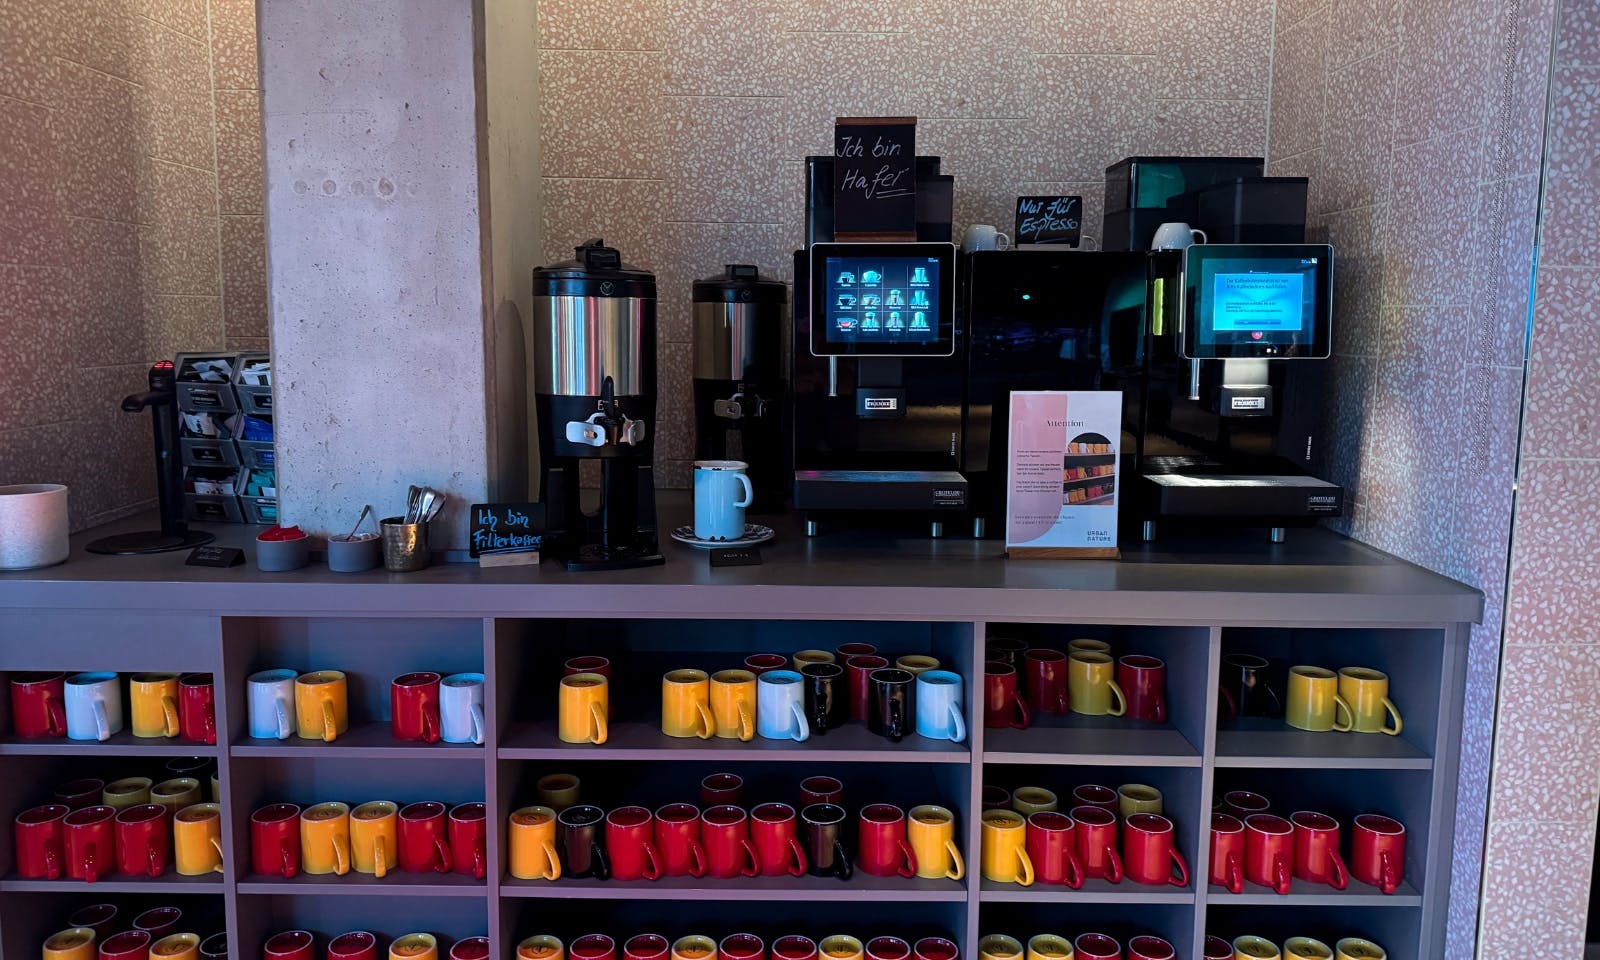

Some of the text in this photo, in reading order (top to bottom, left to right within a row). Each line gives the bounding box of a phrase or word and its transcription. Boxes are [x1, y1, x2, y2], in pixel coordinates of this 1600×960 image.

[836, 136, 902, 158] Ich bin
[842, 165, 910, 199] Hafer
[1018, 198, 1077, 220] Nur für
[1019, 217, 1079, 240] Espresso
[1047, 419, 1084, 428] Attention
[478, 508, 530, 532] Ich bin
[472, 528, 542, 550] Filterkaffee
